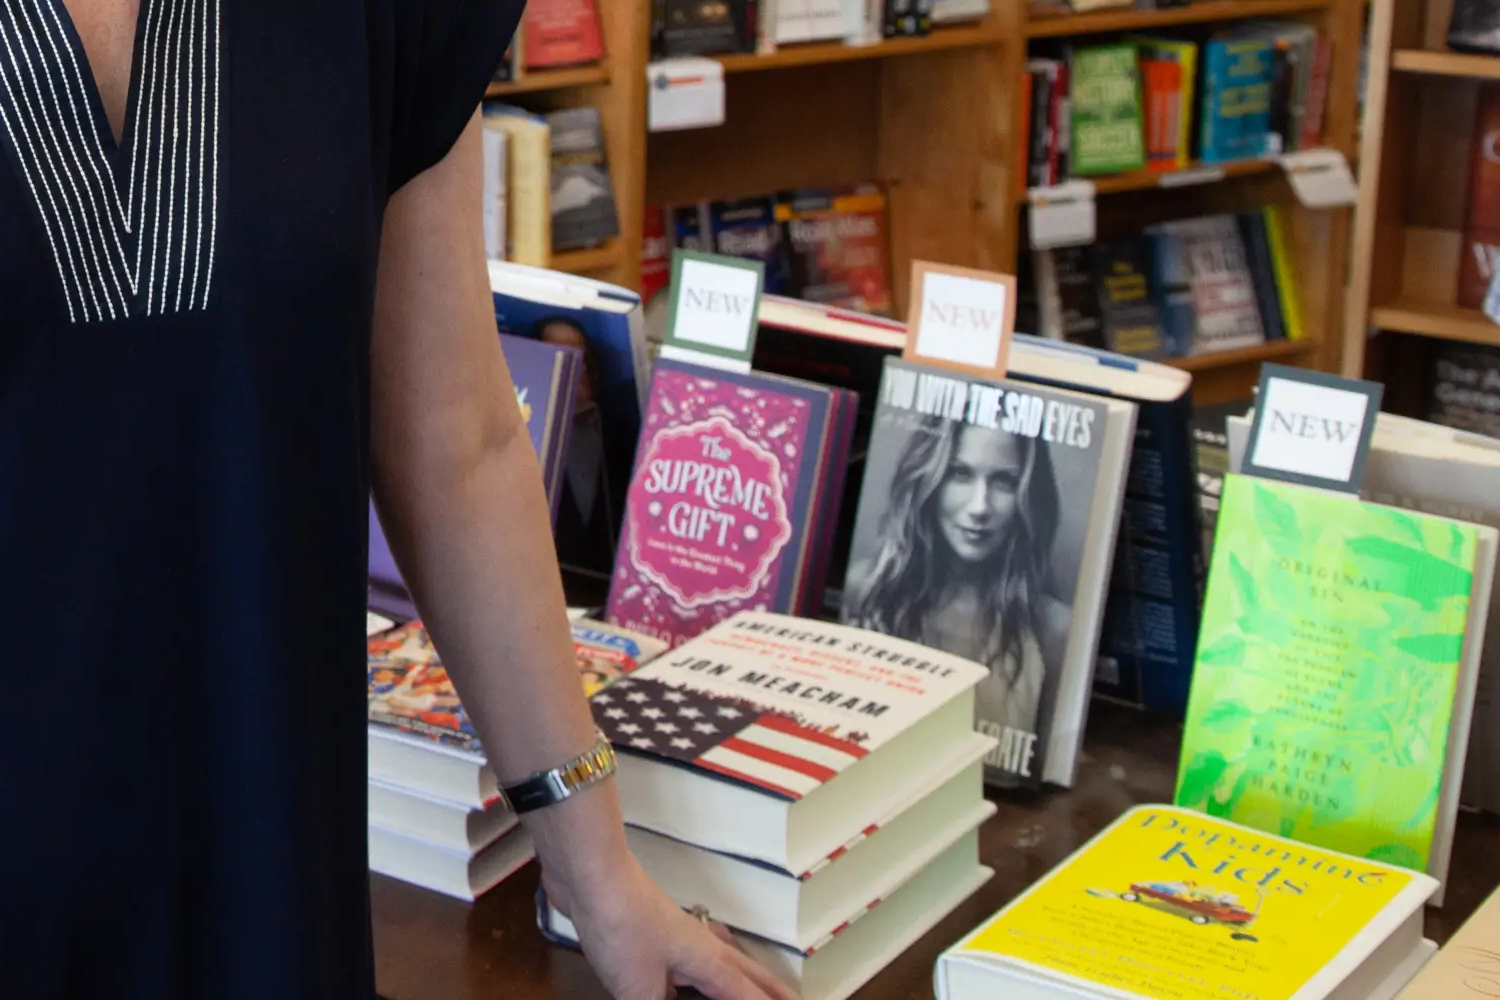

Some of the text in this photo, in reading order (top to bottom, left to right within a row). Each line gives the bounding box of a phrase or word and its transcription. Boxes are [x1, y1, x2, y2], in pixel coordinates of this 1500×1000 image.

[684, 287, 750, 315] NEW
[928, 299, 997, 332] NEW
[884, 366, 917, 411] YOU
[916, 373, 968, 422] WITH
[967, 383, 1004, 429] THE
[1002, 392, 1045, 438] SAD
[1042, 400, 1096, 449] EYES
[1270, 409, 1359, 444] NEW
[699, 435, 732, 461] The
[644, 459, 772, 521] SUPREME
[668, 501, 736, 547] GIFT
[1278, 557, 1382, 592] ORIGINAL
[1309, 585, 1344, 604] SIN
[733, 619, 842, 648] AMERICAN
[670, 656, 733, 678] JON
[738, 671, 891, 719] MEACHAM
[1252, 735, 1353, 773] KATHRYN
[1267, 759, 1330, 787] PAIGE
[1251, 775, 1341, 811] HARDEN
[1139, 813, 1389, 887] Dopamine
[1159, 840, 1311, 896] Kids
